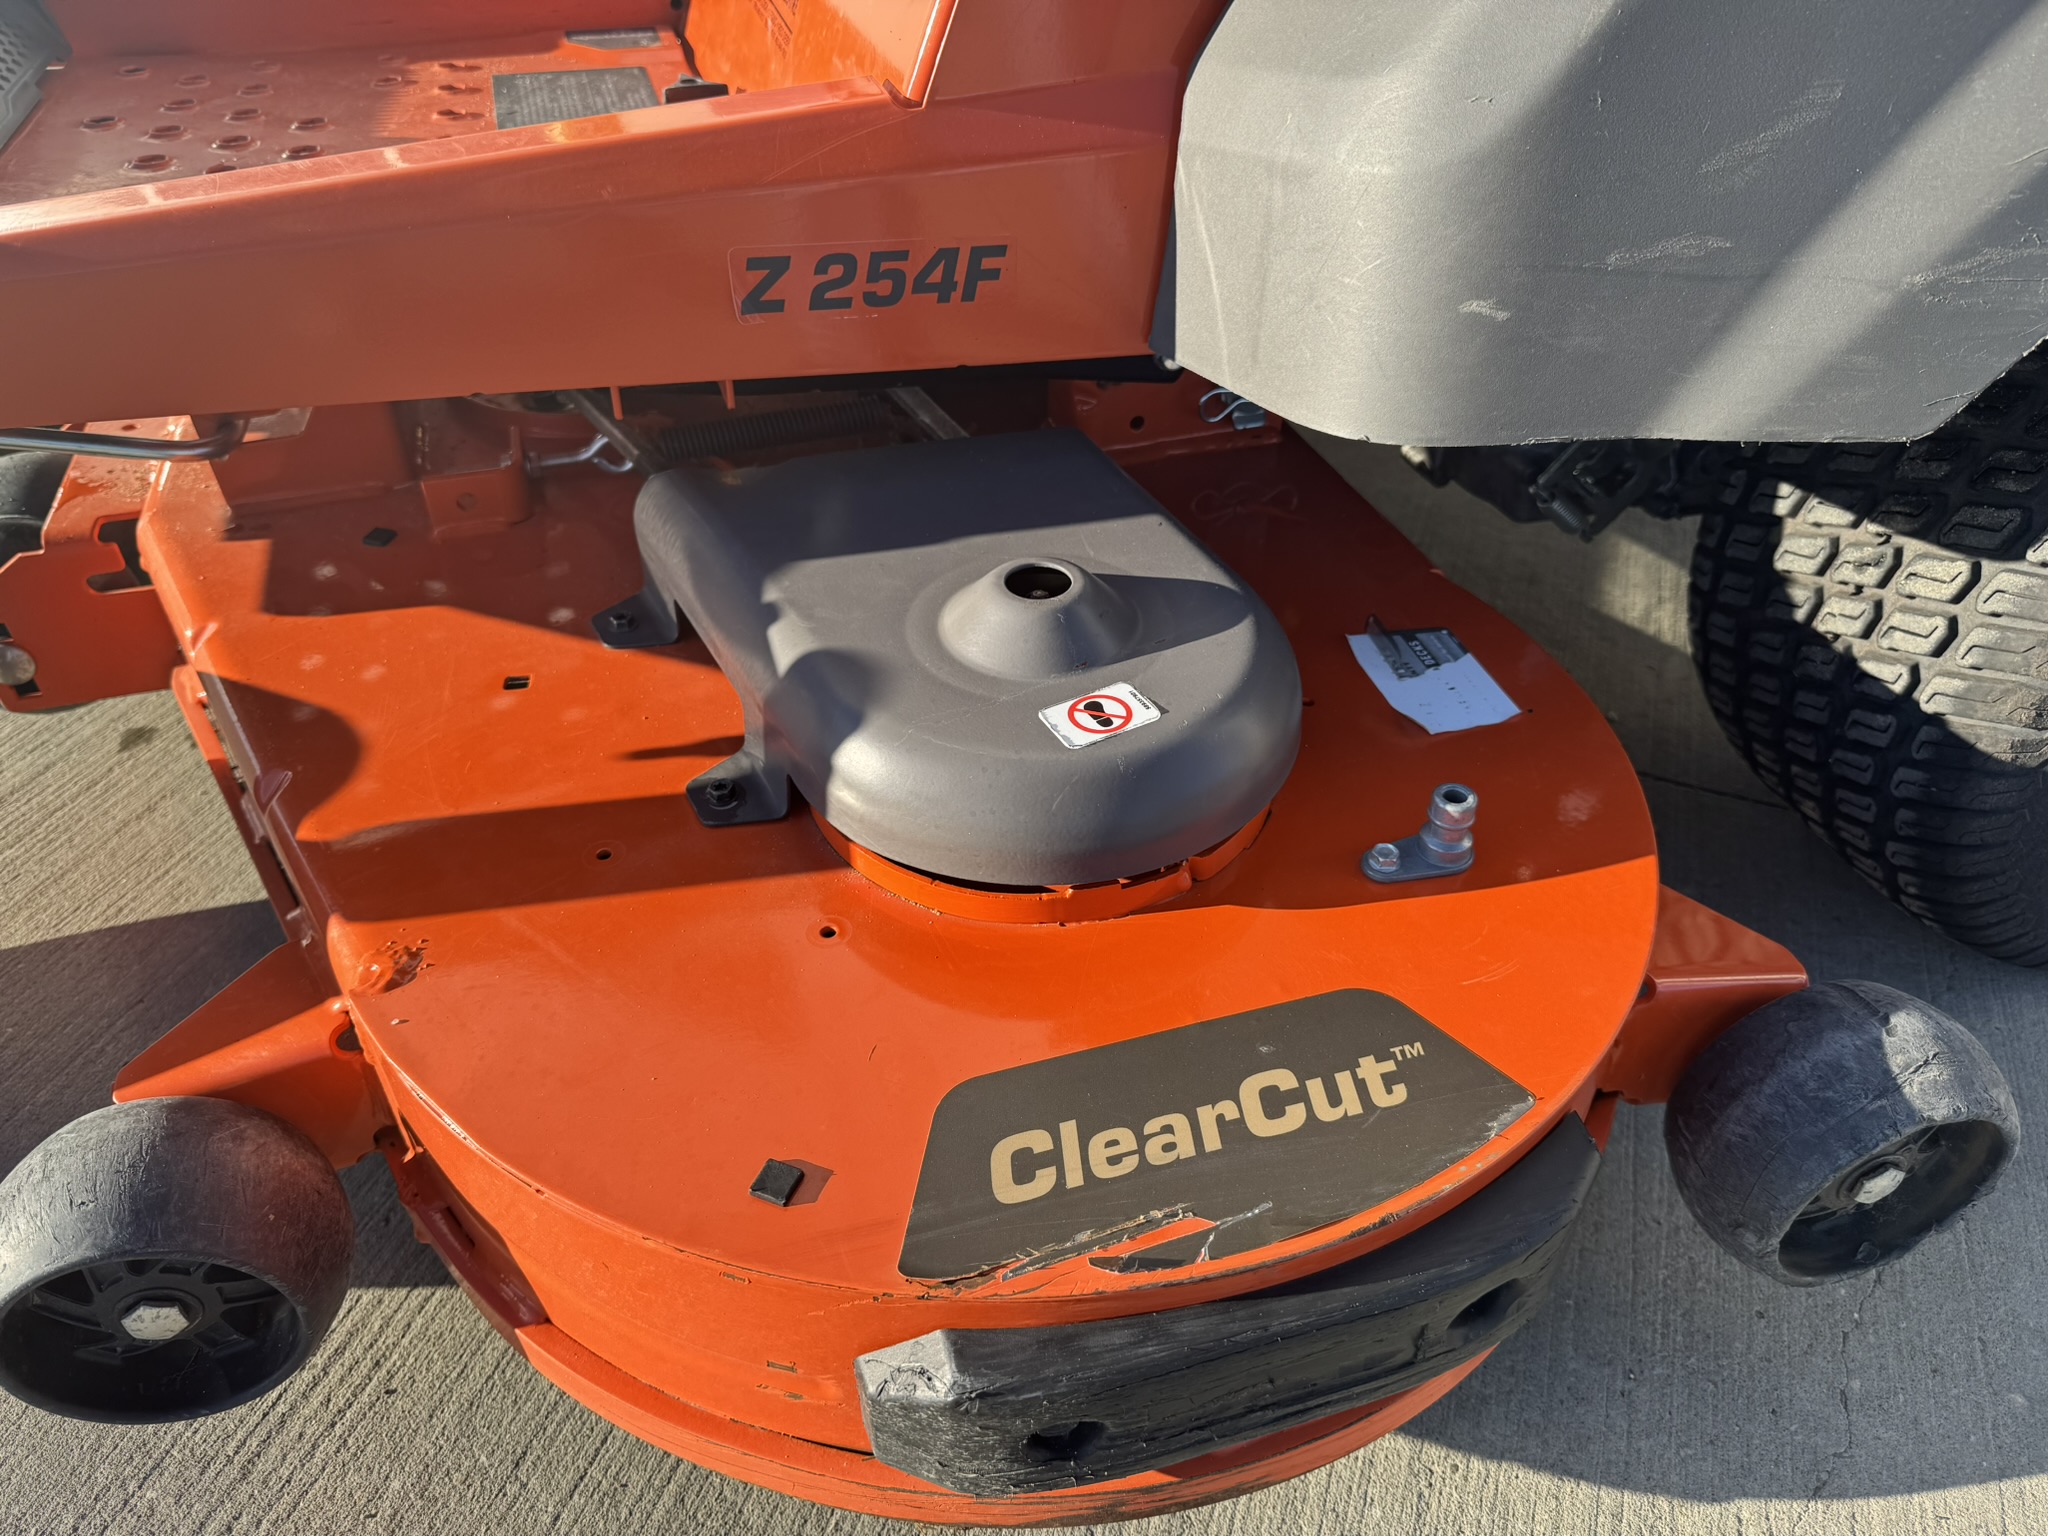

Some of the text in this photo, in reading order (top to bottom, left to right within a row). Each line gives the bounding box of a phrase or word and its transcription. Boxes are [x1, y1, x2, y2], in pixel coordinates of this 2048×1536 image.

[741, 245, 1008, 315] Z 254F
[1408, 639, 1436, 667] DECKS
